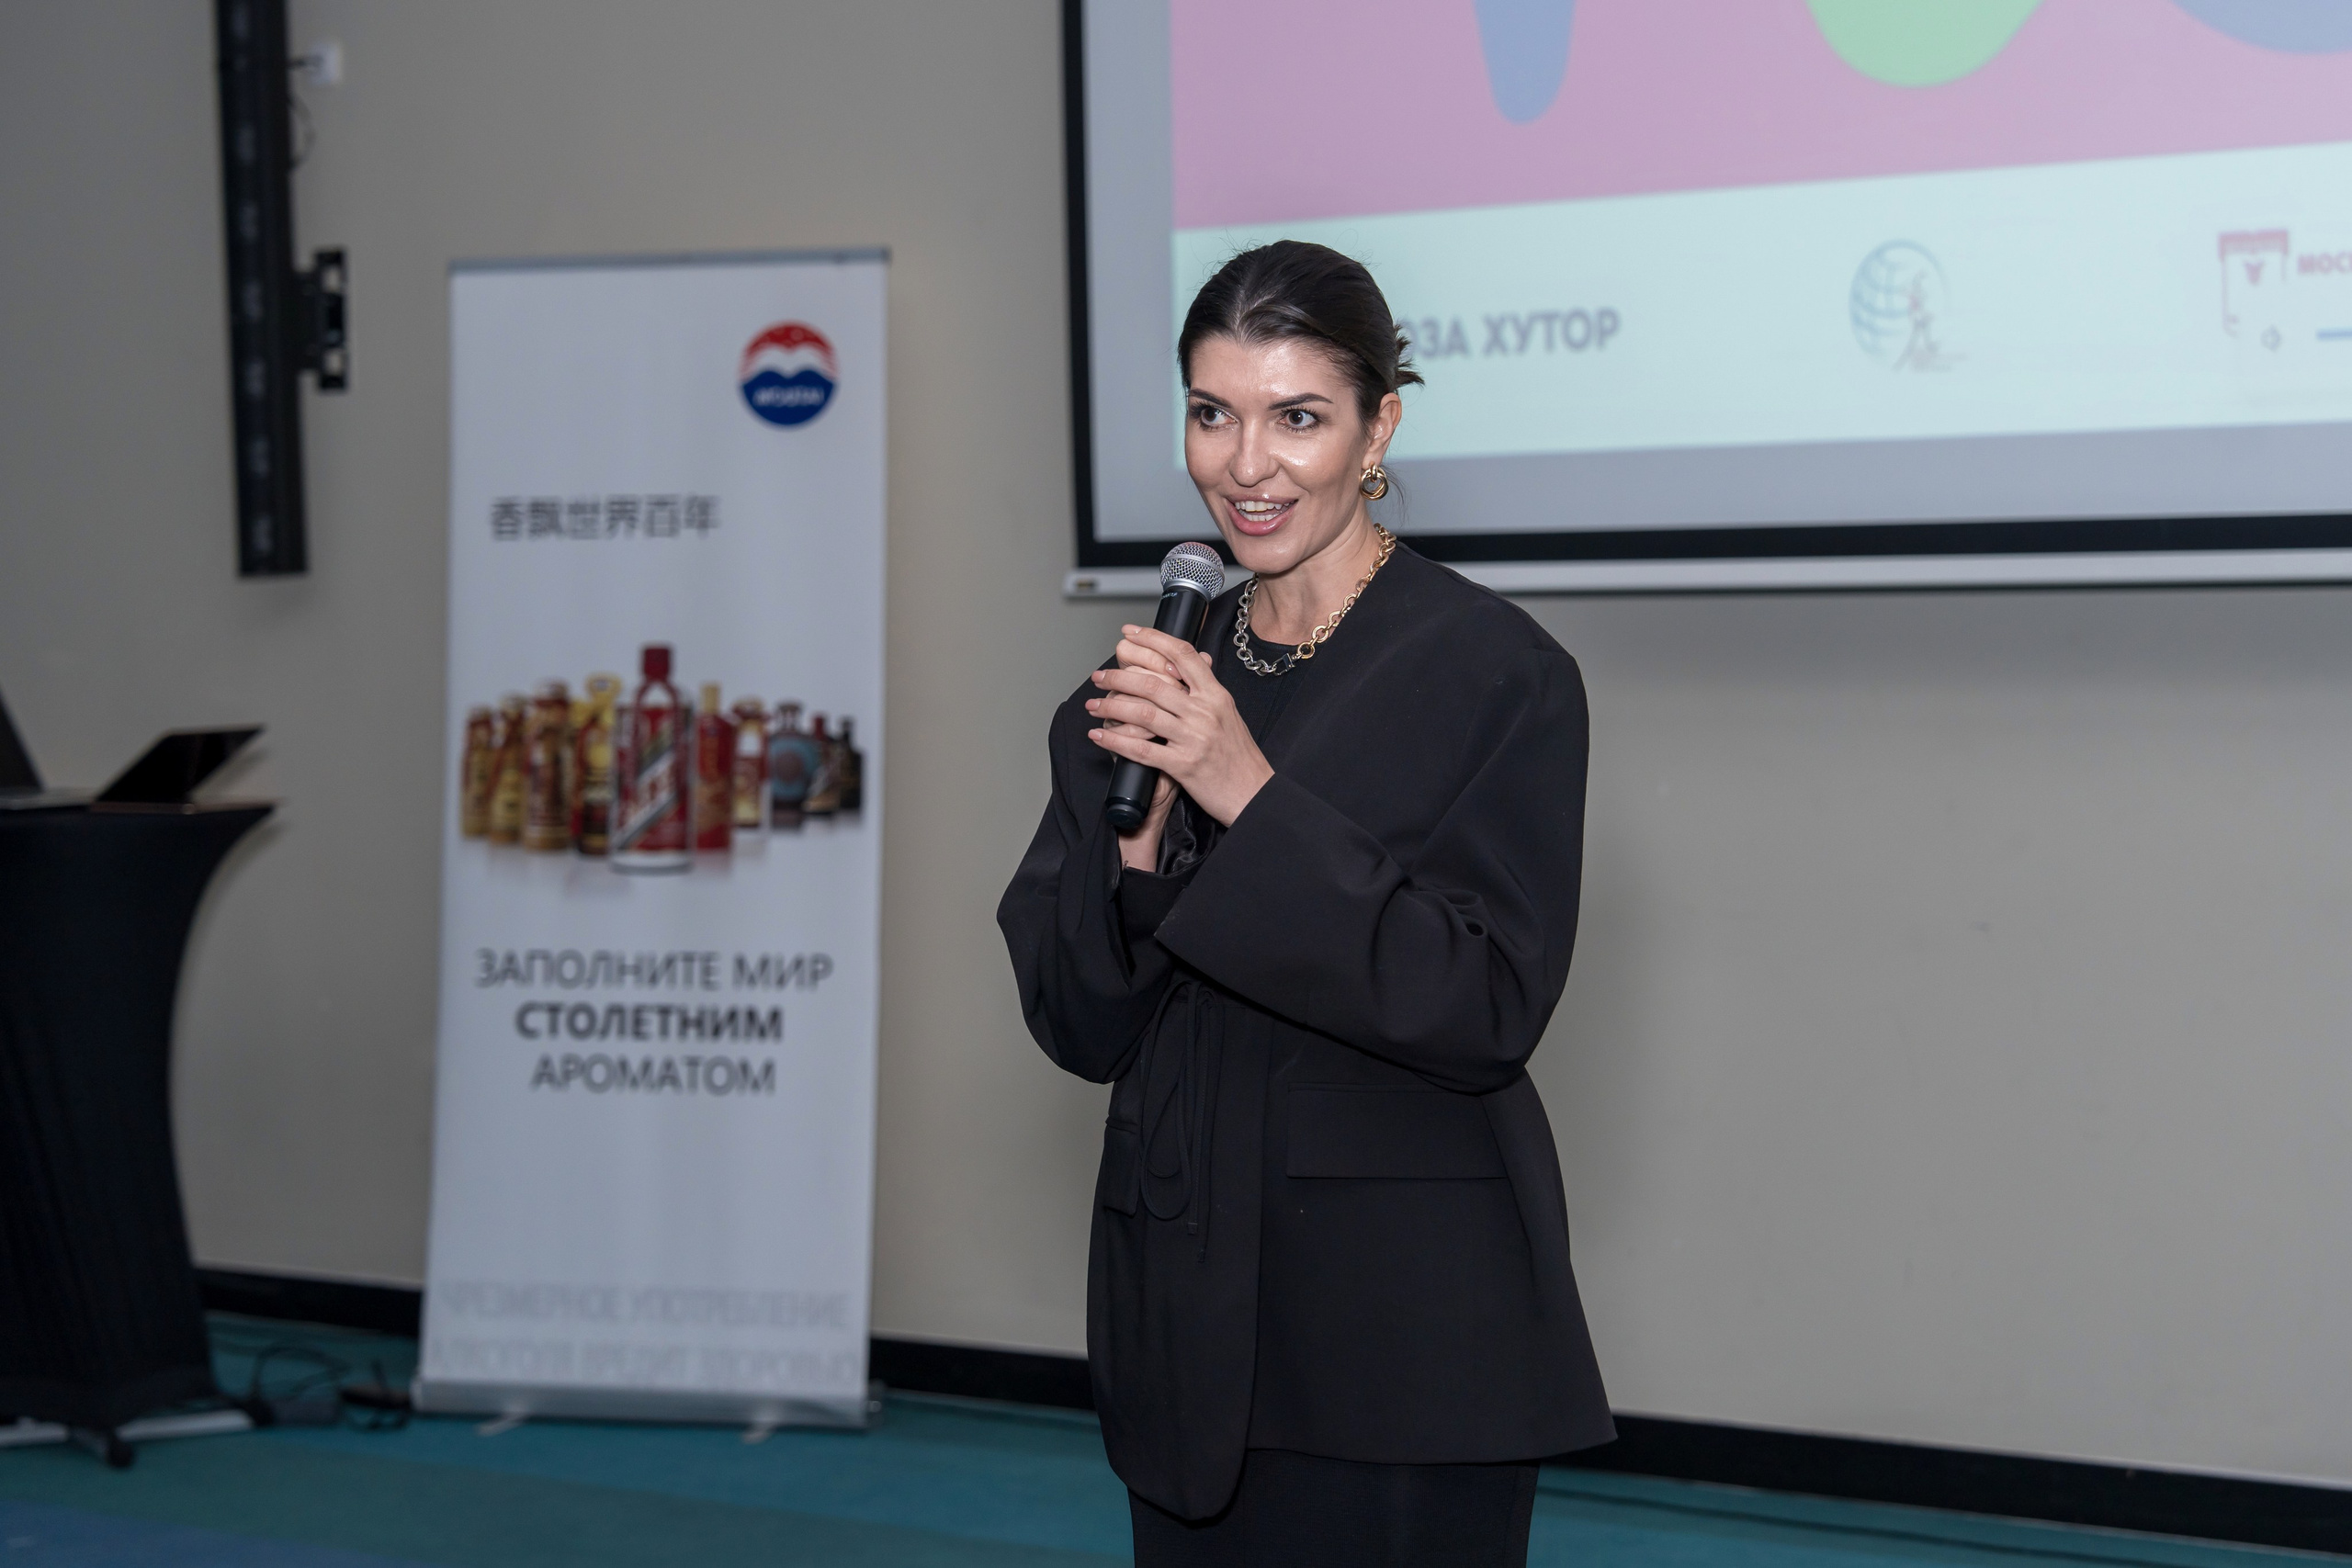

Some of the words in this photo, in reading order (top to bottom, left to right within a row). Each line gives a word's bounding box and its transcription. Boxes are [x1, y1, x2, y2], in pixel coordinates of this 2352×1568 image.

[1395, 316, 1471, 359] ОЗА
[1481, 307, 1621, 356] ХУТОР
[474, 948, 722, 990] ЗАПОЛНИТЕ
[735, 953, 833, 991] МИР
[515, 1002, 783, 1042] СТОЛЕТНИМ
[530, 1054, 776, 1096] АРОМАТОМ
